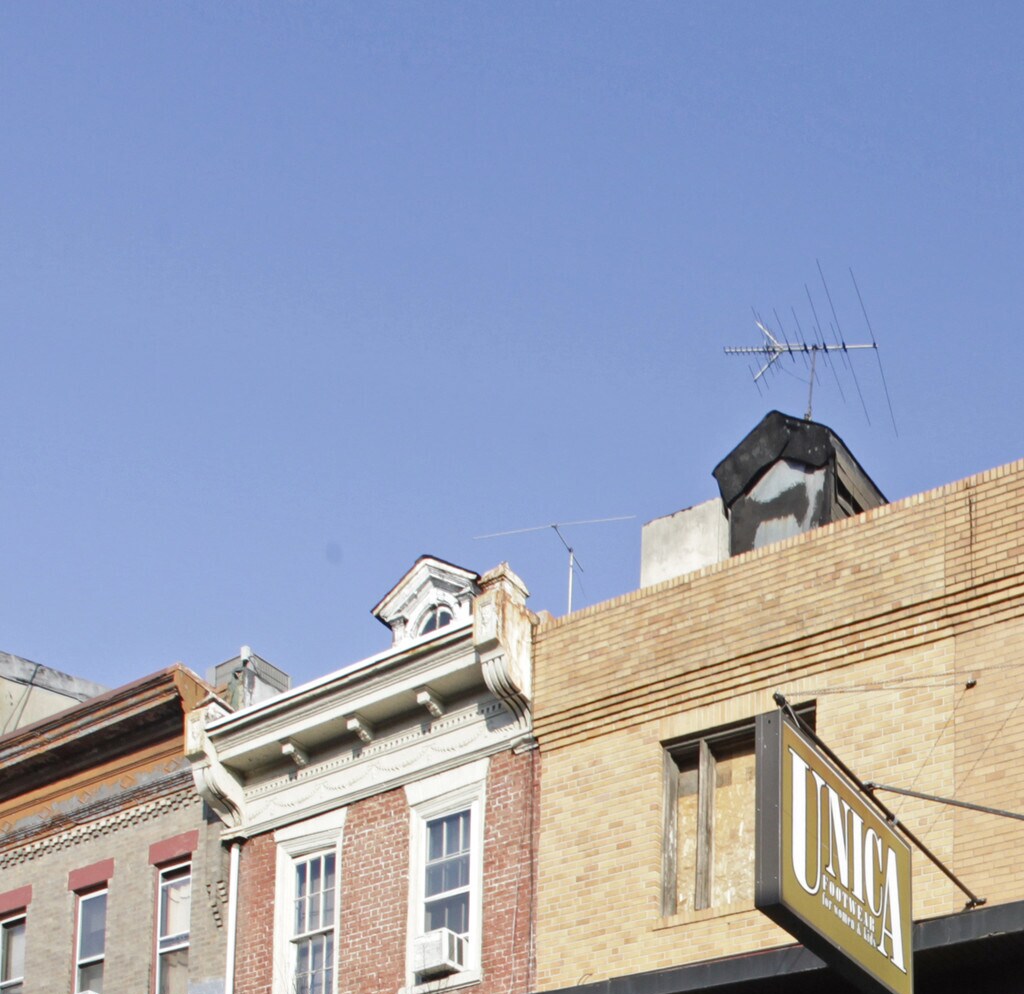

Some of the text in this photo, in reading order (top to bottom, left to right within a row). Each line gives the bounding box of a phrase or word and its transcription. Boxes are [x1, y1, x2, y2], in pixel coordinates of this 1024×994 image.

[788, 745, 908, 975] UNICA
[822, 874, 876, 933] FOOTWEAR
[822, 891, 832, 910] for
[834, 904, 855, 930] women
